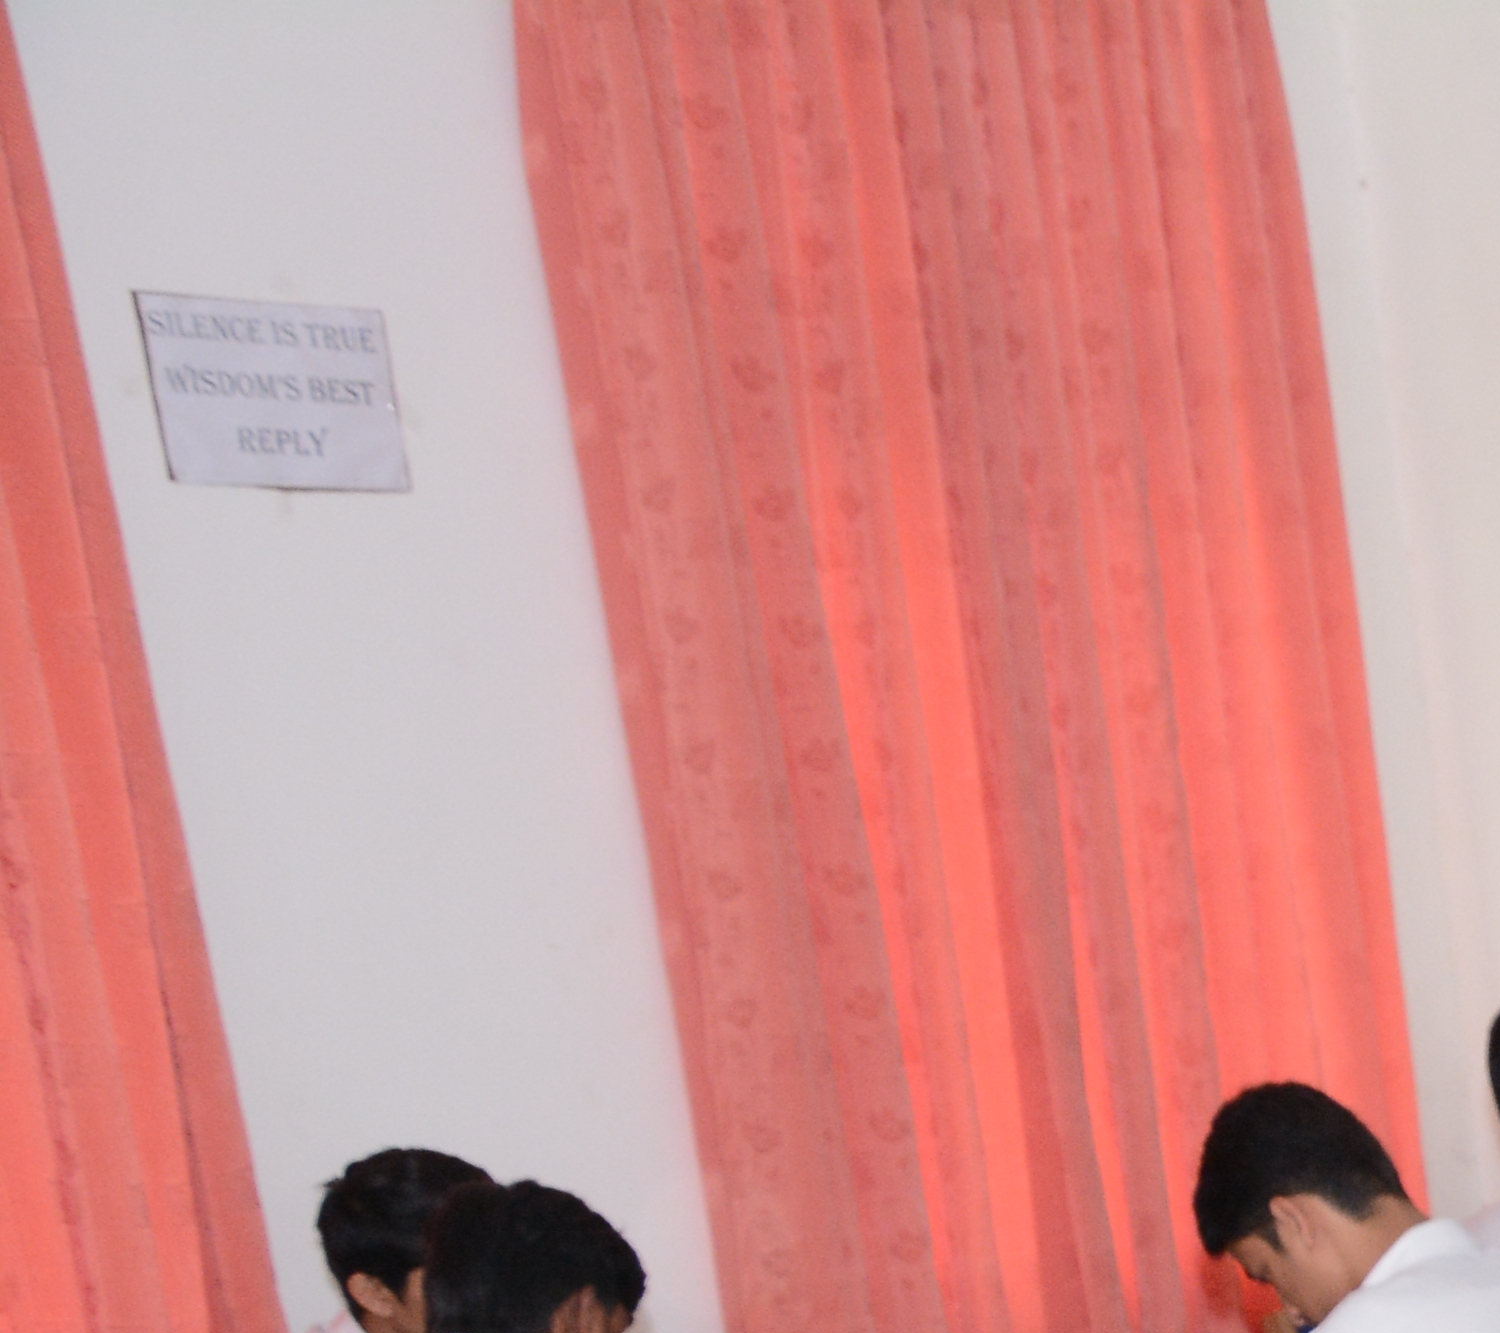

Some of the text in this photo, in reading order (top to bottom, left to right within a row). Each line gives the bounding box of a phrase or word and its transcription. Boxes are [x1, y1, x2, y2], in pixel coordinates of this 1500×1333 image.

[148, 310, 377, 353] SILENCE IS TRUE
[165, 364, 375, 407] WISDOM'S BEST
[237, 425, 329, 457] REPLY
